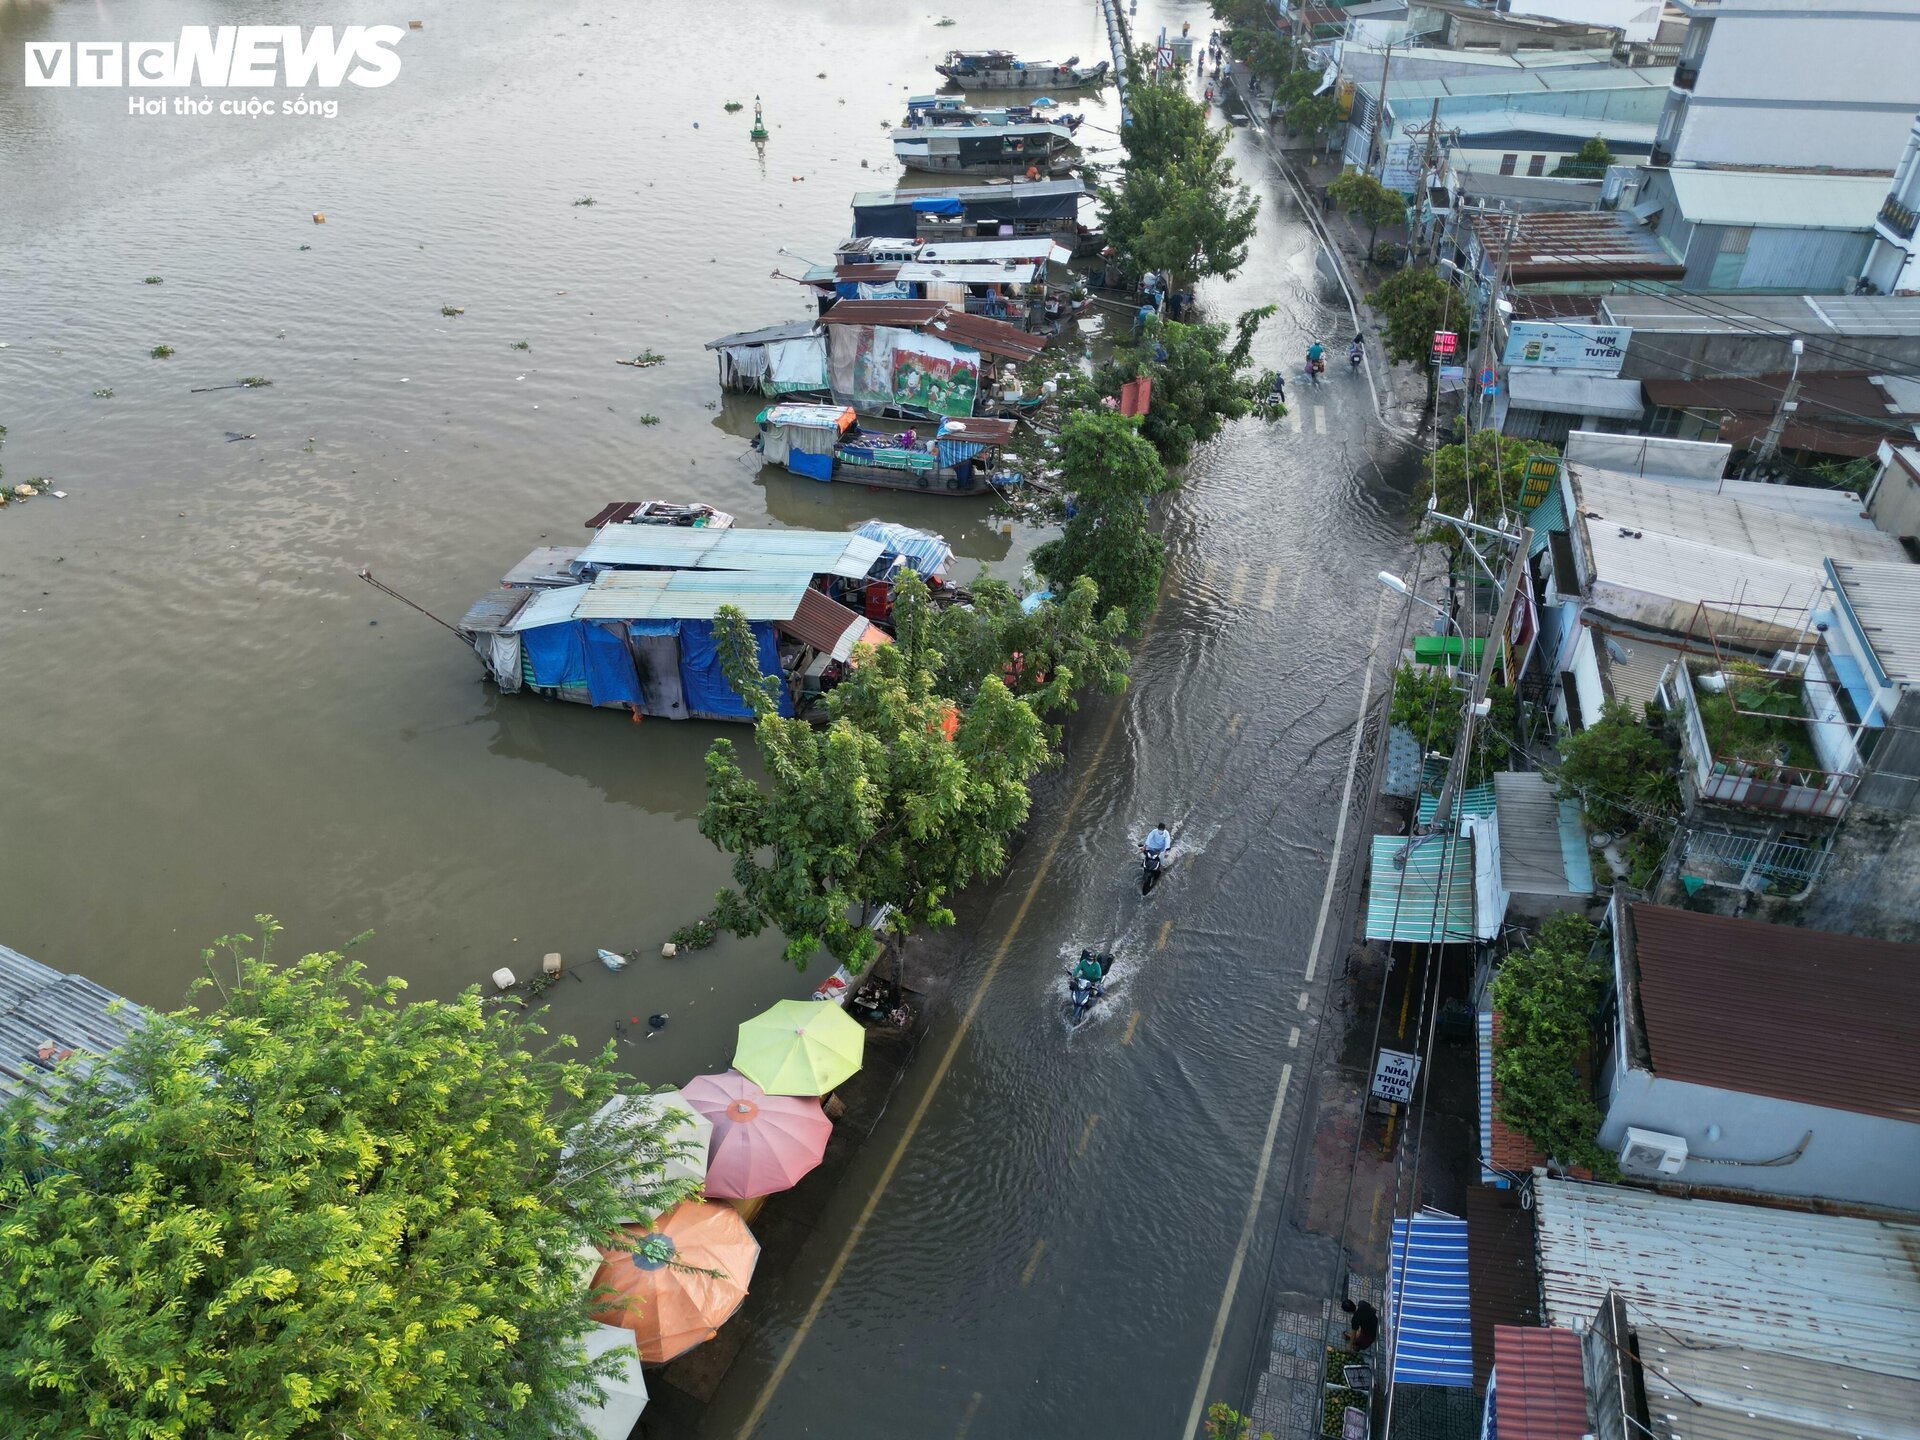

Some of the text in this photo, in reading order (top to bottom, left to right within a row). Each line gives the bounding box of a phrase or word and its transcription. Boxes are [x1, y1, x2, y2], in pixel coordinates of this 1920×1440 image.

[1596, 336, 1617, 345] KIM
[1585, 345, 1621, 358] TUYẾN
[1530, 461, 1556, 476] BÁNH
[1526, 478, 1549, 492] SINH
[1384, 1065, 1409, 1077] NHÀ
[1381, 1084, 1404, 1096] TÂY
